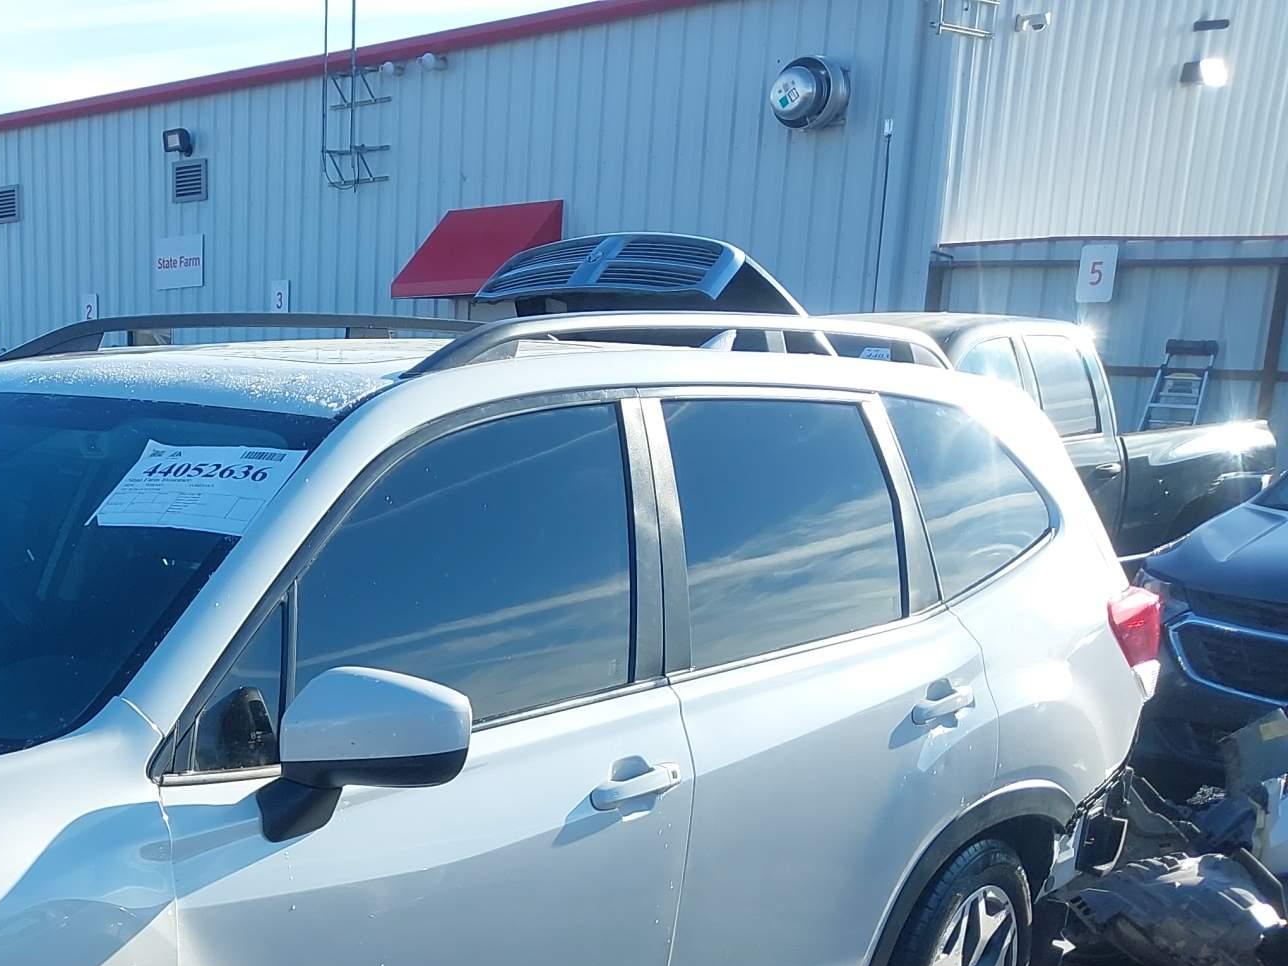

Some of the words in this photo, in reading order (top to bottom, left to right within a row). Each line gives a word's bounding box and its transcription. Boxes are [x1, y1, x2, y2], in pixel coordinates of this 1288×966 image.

[157, 257, 178, 270] State
[179, 255, 201, 268] Farm
[1089, 261, 1104, 285] 5
[276, 291, 283, 309] 3
[86, 304, 93, 320] 2
[142, 463, 273, 482] 44052636
